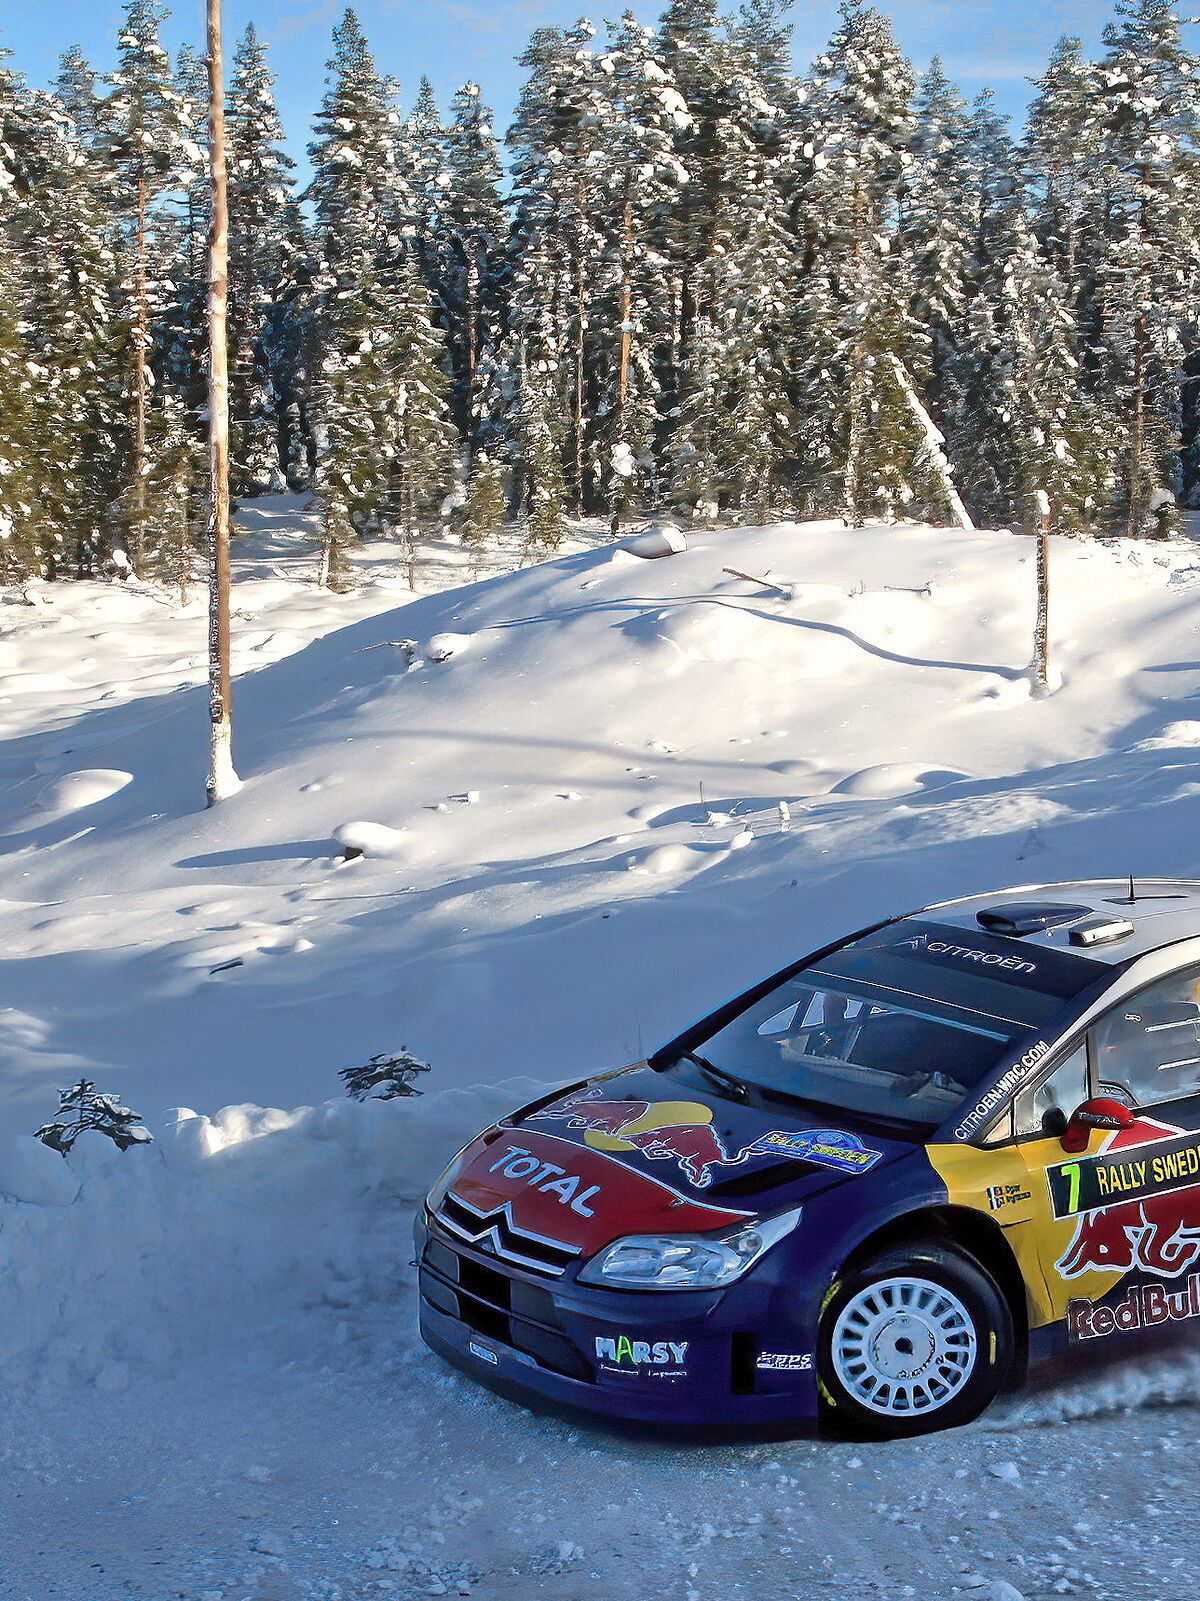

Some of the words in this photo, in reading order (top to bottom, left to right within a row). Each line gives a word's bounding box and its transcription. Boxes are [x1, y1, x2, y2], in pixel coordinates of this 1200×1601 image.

[953, 1040, 1051, 1140] CITROEN-WRC.COM
[488, 1145, 601, 1218] TOTAL
[1061, 1164, 1081, 1214] 7
[1096, 1160, 1146, 1196] RALLY
[595, 1335, 688, 1365] MARSY
